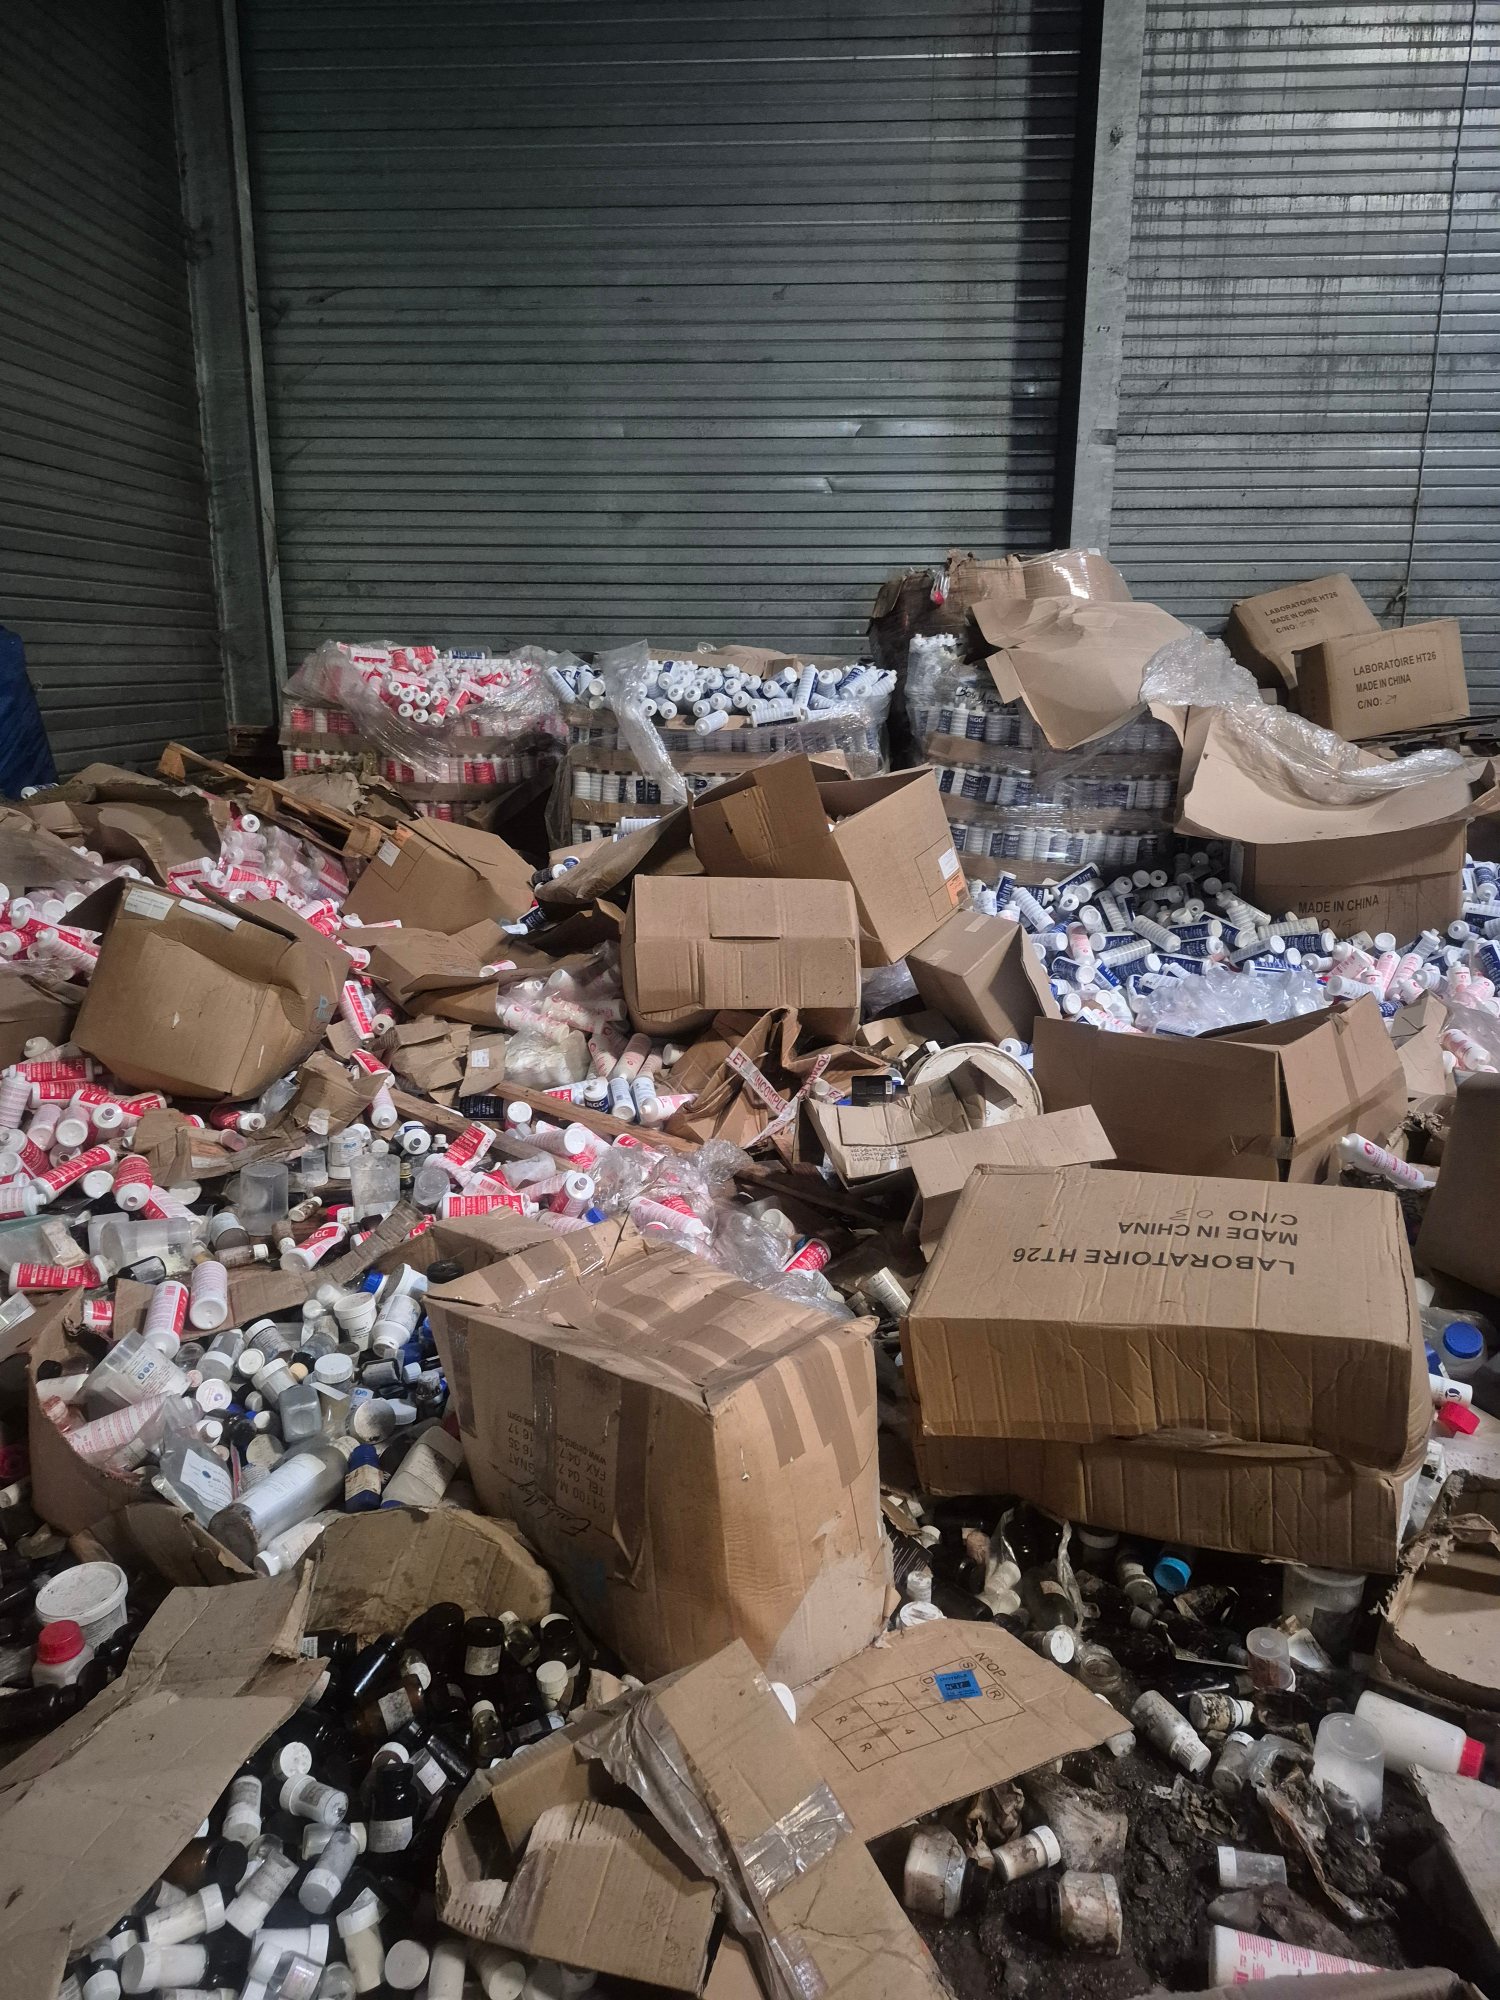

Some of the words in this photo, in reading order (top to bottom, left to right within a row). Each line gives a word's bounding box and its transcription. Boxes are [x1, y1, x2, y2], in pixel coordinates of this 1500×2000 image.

[1264, 596, 1319, 617] LABORATOIRE
[1319, 591, 1339, 602] HT26
[1270, 614, 1290, 626] MADE
[1290, 613, 1298, 621] IN
[1298, 607, 1320, 618] CHINA
[1353, 656, 1415, 676] LABORATOIRE
[1416, 651, 1437, 665] HT26
[1356, 680, 1379, 694] MADE
[1379, 678, 1388, 690] IN
[1388, 674, 1412, 687] CHINA
[1357, 696, 1382, 710] C/NO:
[1298, 902, 1330, 914] MADE
[1334, 901, 1344, 913] IN
[1347, 894, 1379, 911] CHINA
[1229, 1209, 1298, 1226] C/NO
[1118, 1221, 1190, 1237] CHINA
[1197, 1226, 1220, 1238] IN
[1227, 1227, 1298, 1246] MADE
[1012, 1247, 1078, 1263] HT26
[1084, 1249, 1296, 1275] LABORATOIRE
[508, 1437, 520, 1451] 35
[568, 1452, 581, 1466] 04
[568, 1469, 581, 1482] 04
[586, 1462, 606, 1481] FAX
[589, 1480, 605, 1497] TEL
[572, 1487, 605, 1514] 01100
[962, 1661, 974, 1669] S
[923, 1676, 934, 1685] D
[989, 1691, 1002, 1699] R
[835, 1715, 848, 1725] R
[859, 1742, 872, 1753] R
